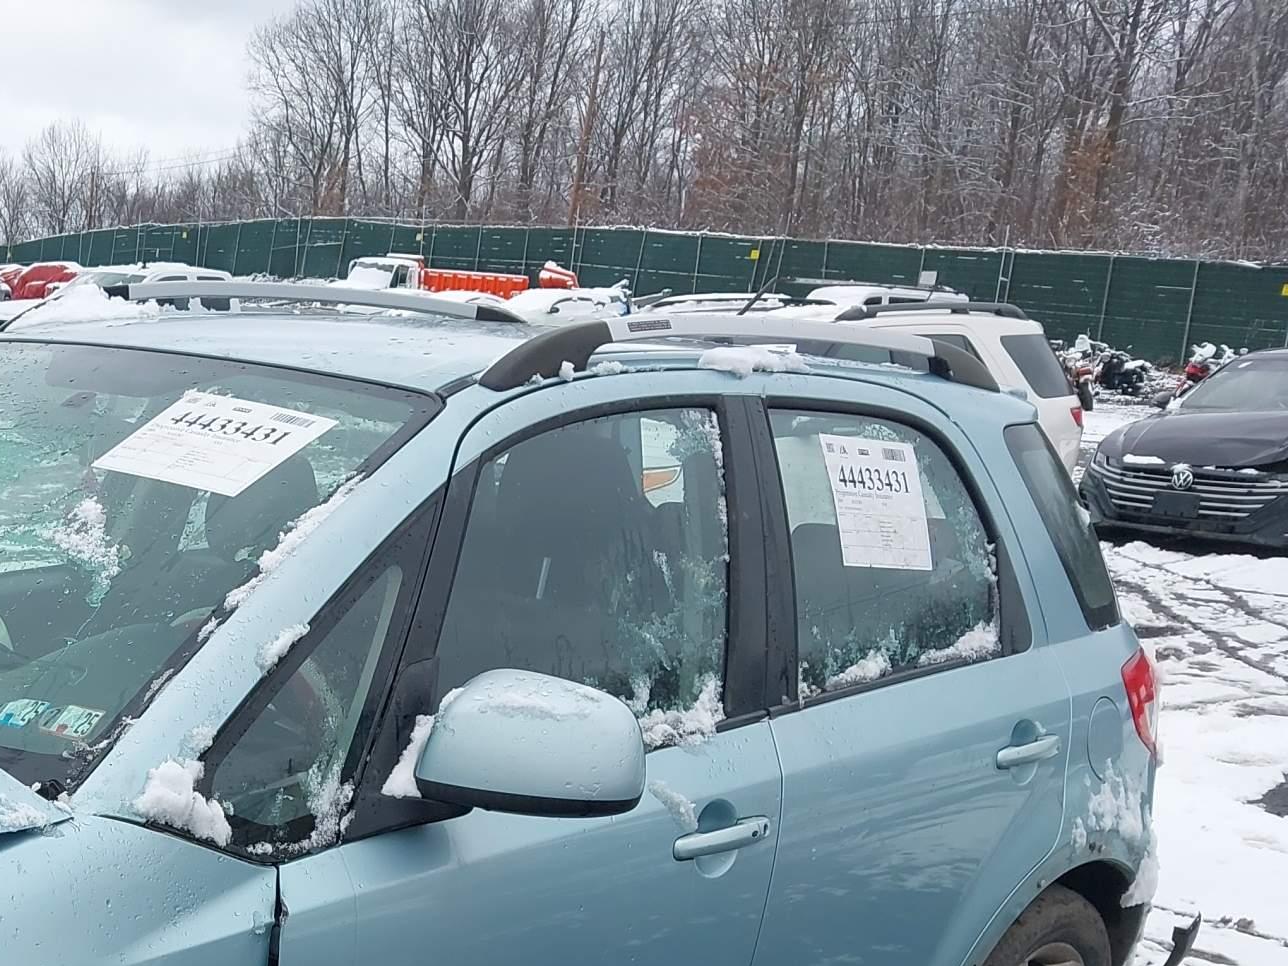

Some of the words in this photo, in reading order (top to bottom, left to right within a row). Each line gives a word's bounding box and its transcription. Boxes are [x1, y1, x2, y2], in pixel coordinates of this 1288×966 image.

[171, 411, 292, 445] 44433431
[838, 464, 911, 493] 44433431
[73, 712, 99, 735] 25
